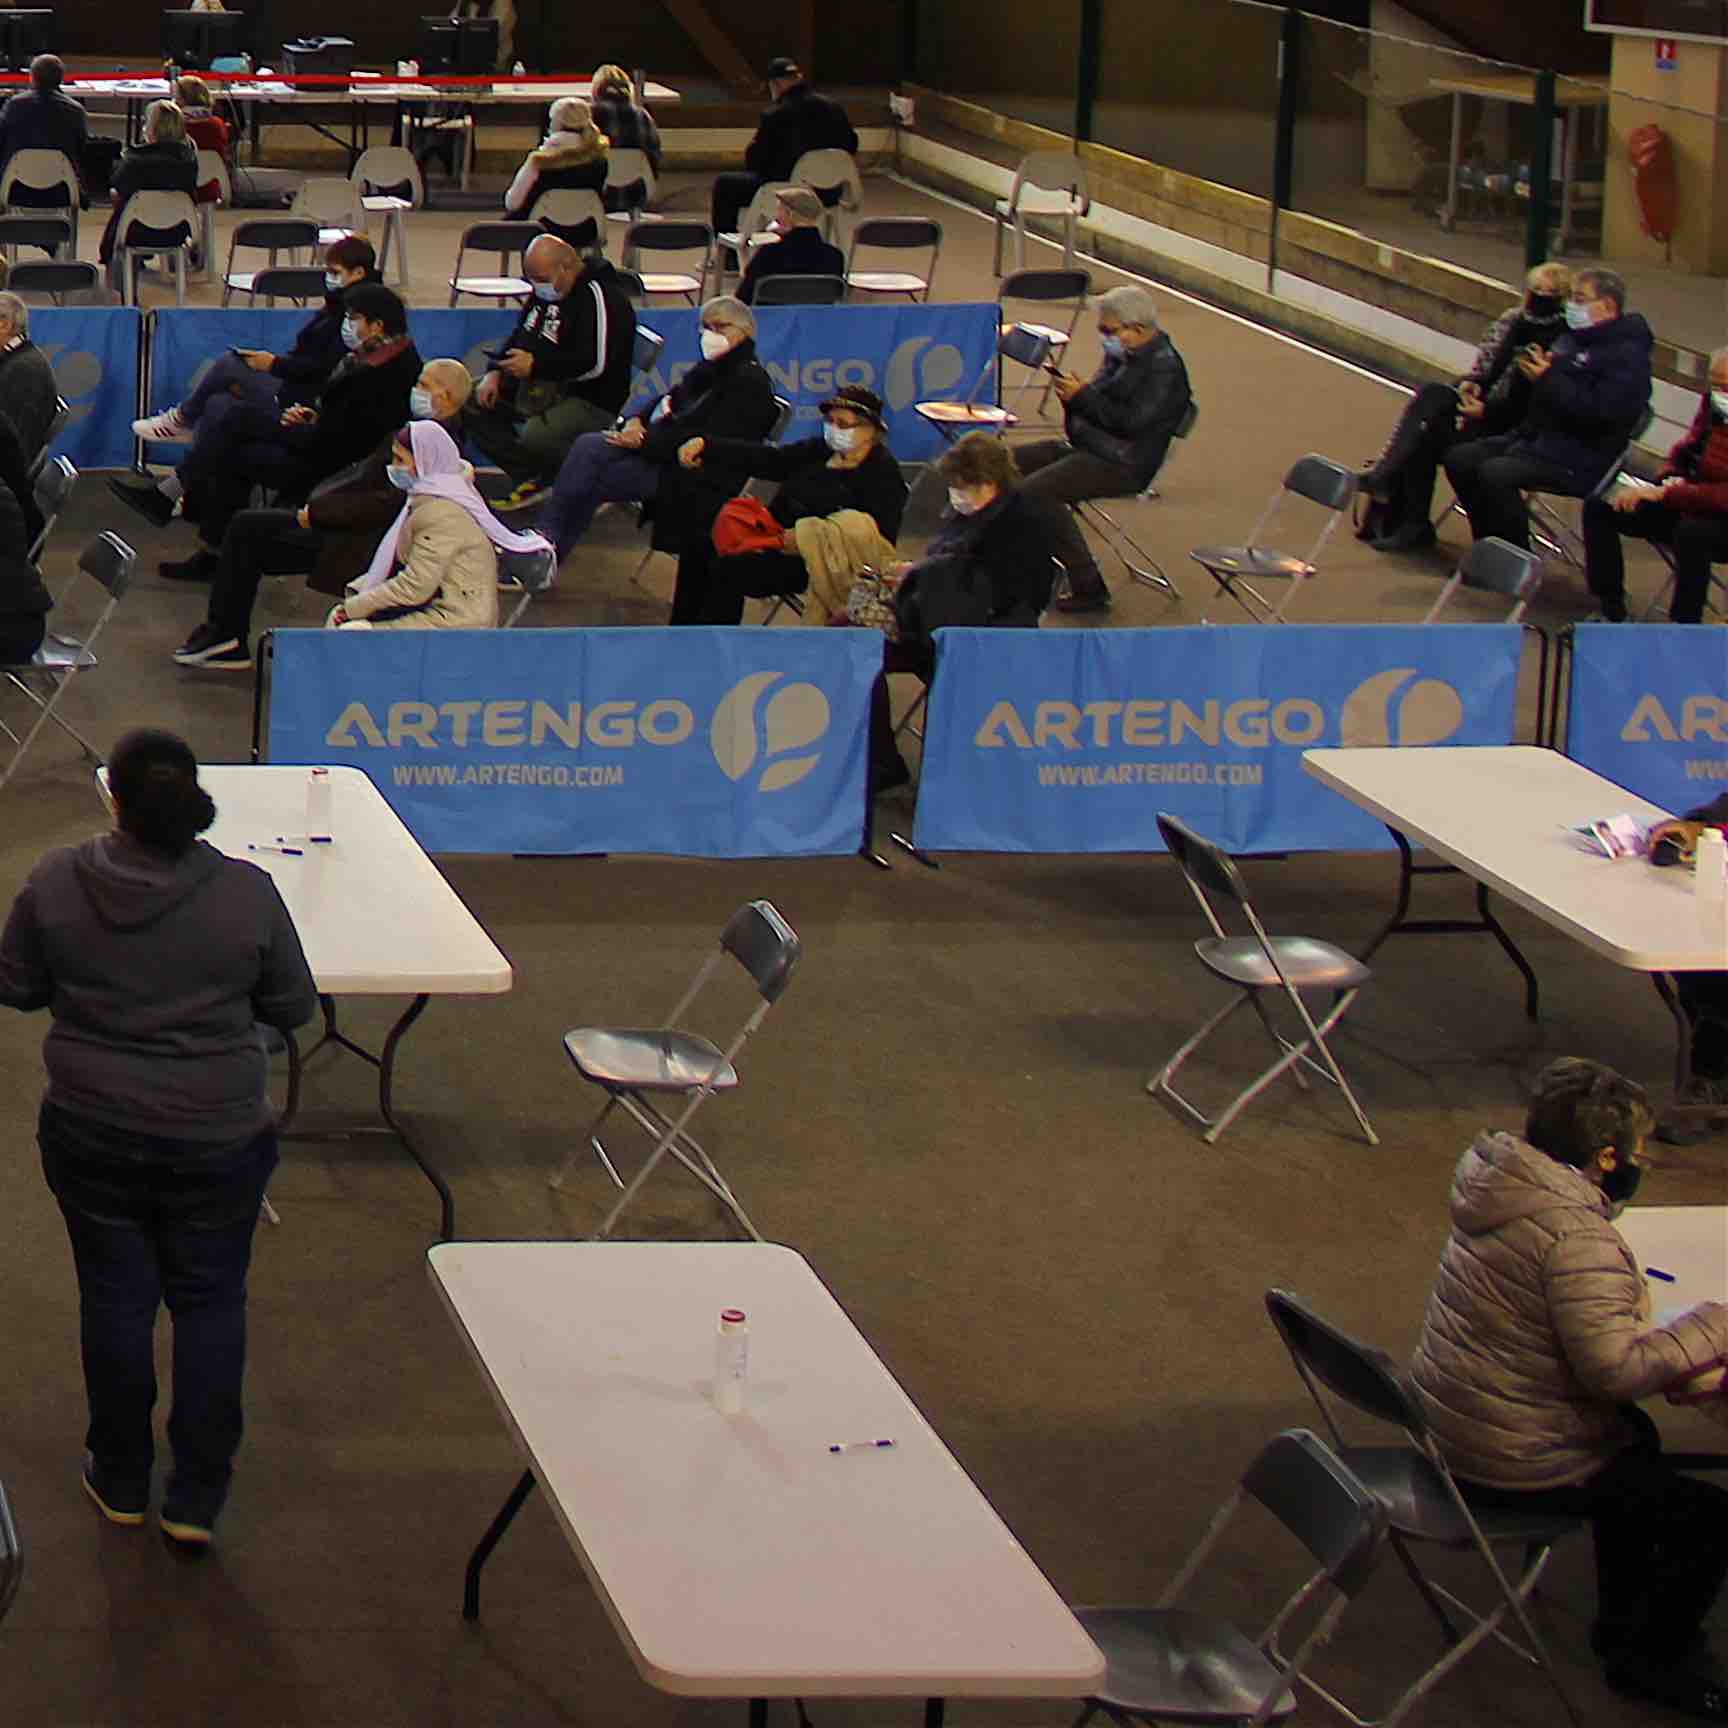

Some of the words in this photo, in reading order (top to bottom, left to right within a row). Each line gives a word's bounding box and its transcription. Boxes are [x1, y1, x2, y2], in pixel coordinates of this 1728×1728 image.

[325, 699, 695, 750] ARTENGO
[974, 698, 1326, 750] ARTENGO
[392, 762, 625, 788] WWW.ARTENGO.COM
[1038, 762, 1264, 786] WWW.ARTENGO.COM
